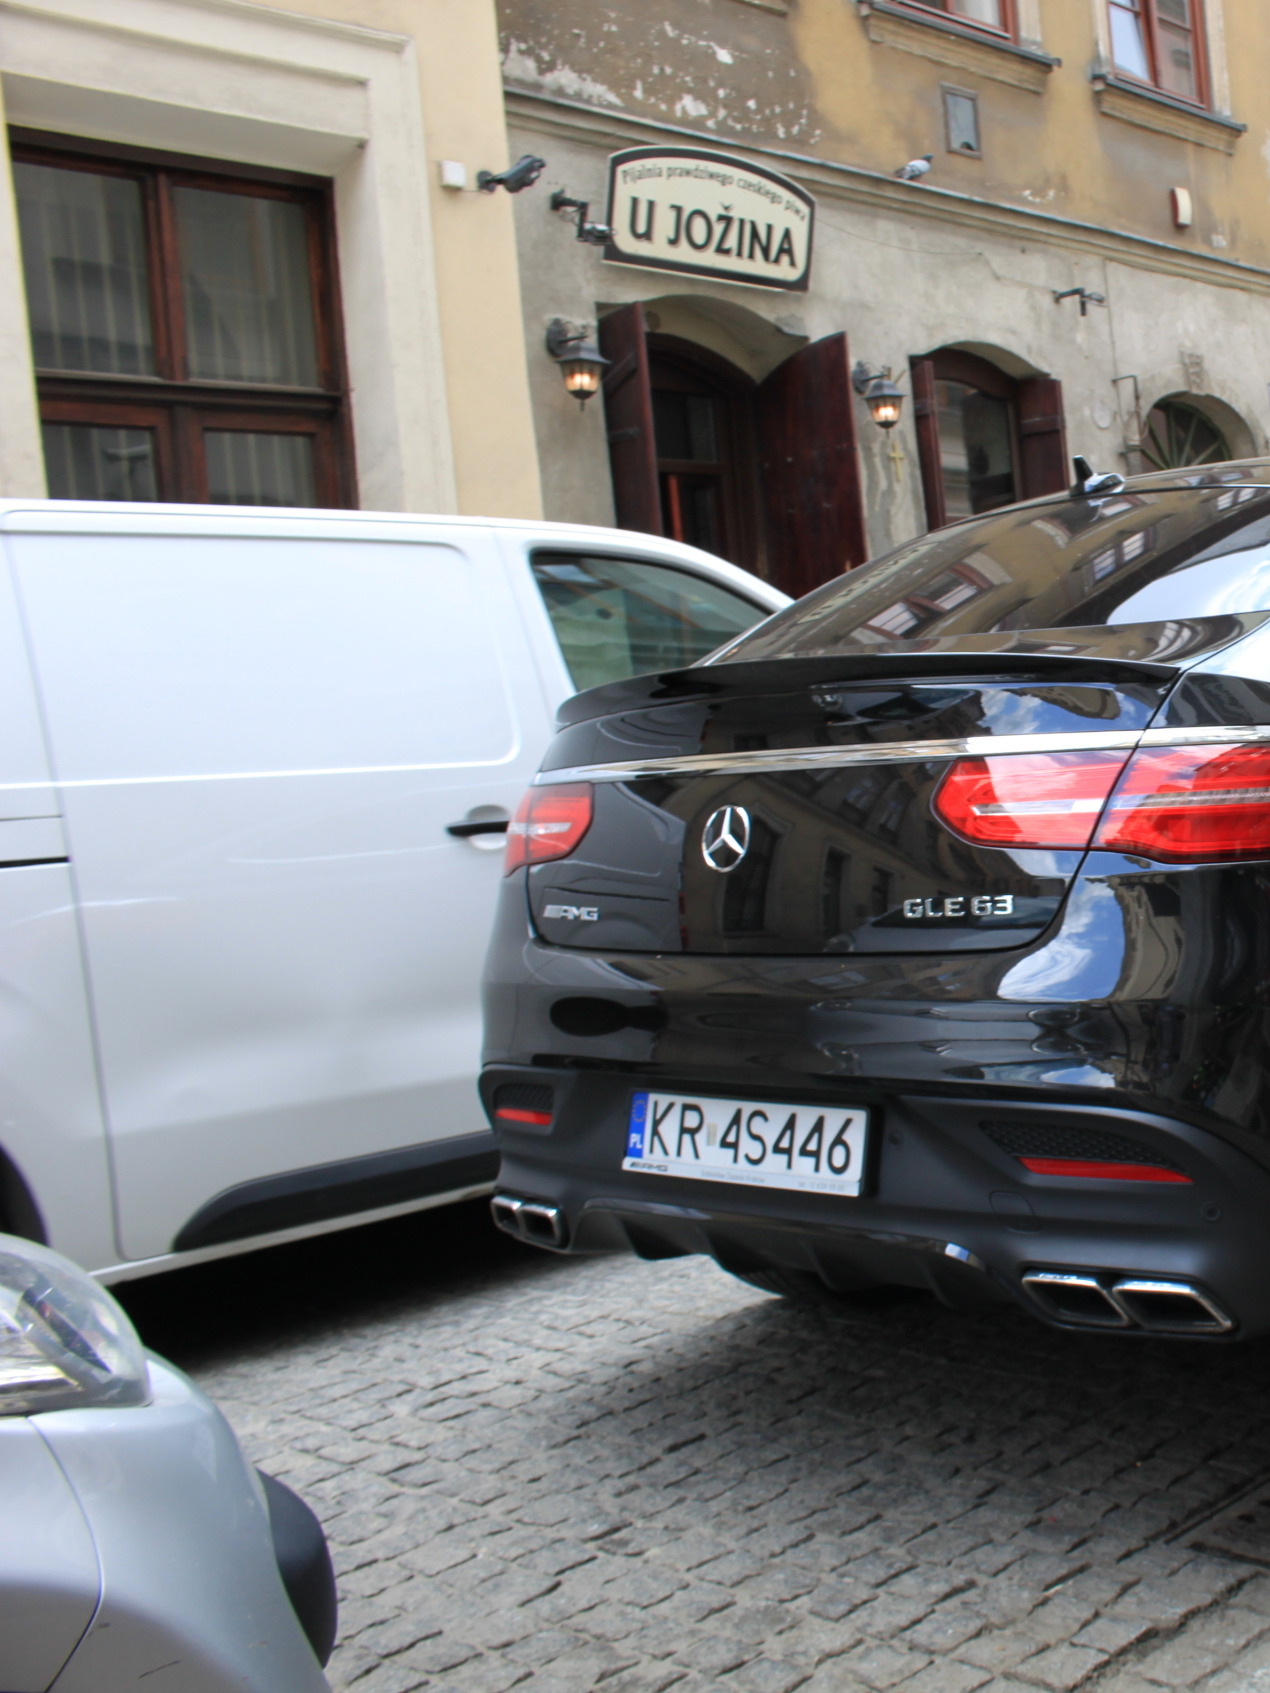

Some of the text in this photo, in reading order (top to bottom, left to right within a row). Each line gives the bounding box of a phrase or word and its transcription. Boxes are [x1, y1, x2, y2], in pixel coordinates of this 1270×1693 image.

[621, 164, 806, 221] Pijalnia prawdziwego czeskiego piwa
[630, 196, 798, 268] U JOŽINA
[552, 905, 599, 921] AMG
[903, 894, 1015, 918] GLE 63
[629, 1132, 643, 1149] PL
[648, 1100, 855, 1176] KR 4S446
